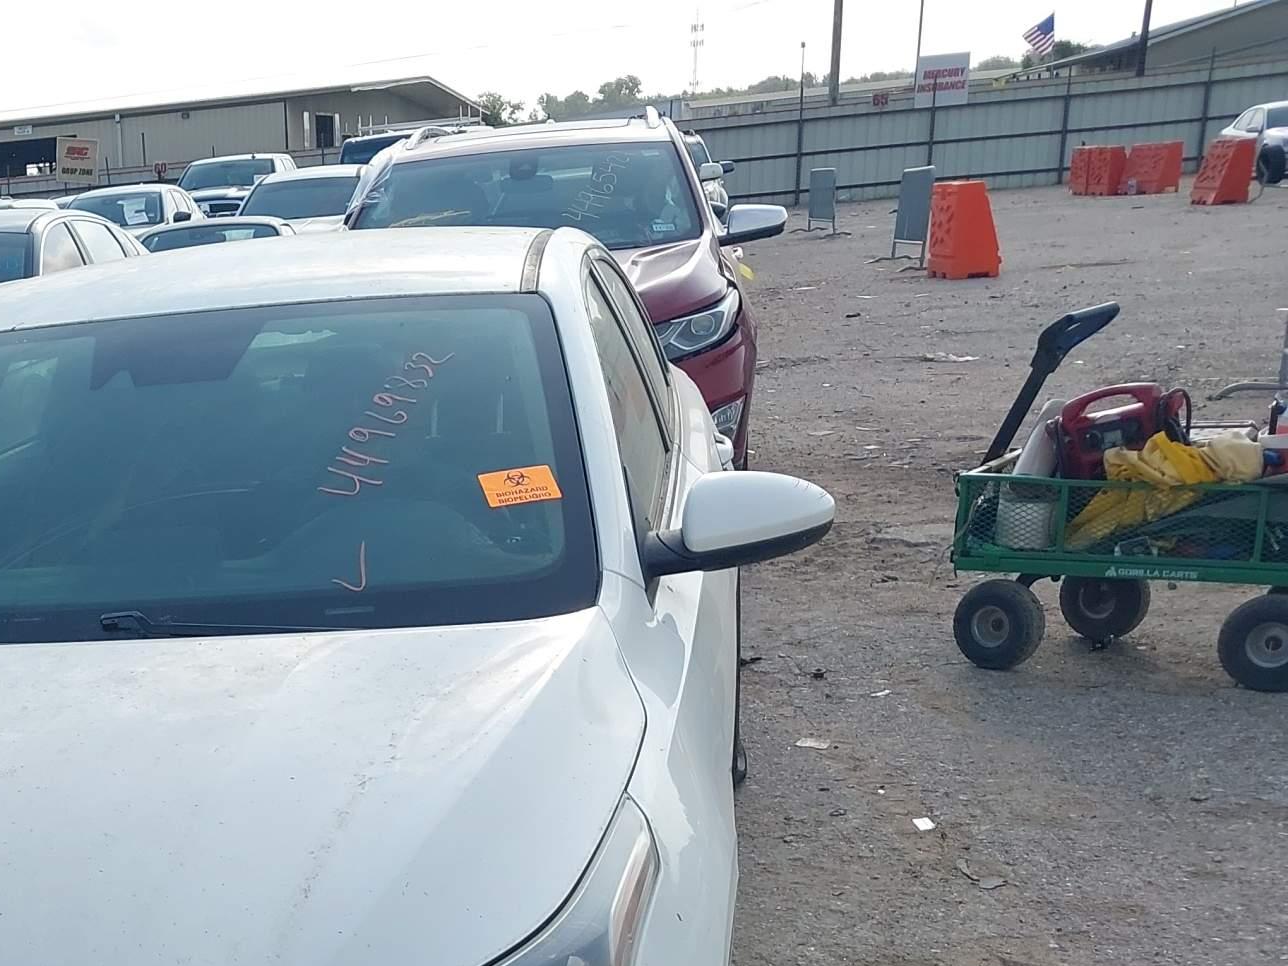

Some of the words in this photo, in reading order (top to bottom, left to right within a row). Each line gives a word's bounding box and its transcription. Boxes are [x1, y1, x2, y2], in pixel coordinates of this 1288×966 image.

[923, 67, 966, 80] MERCURY
[317, 352, 455, 495] 44969832
[496, 486, 548, 497] BIOHAZARD
[1118, 567, 1160, 577] GORILLA
[1162, 570, 1199, 579] CARTS
